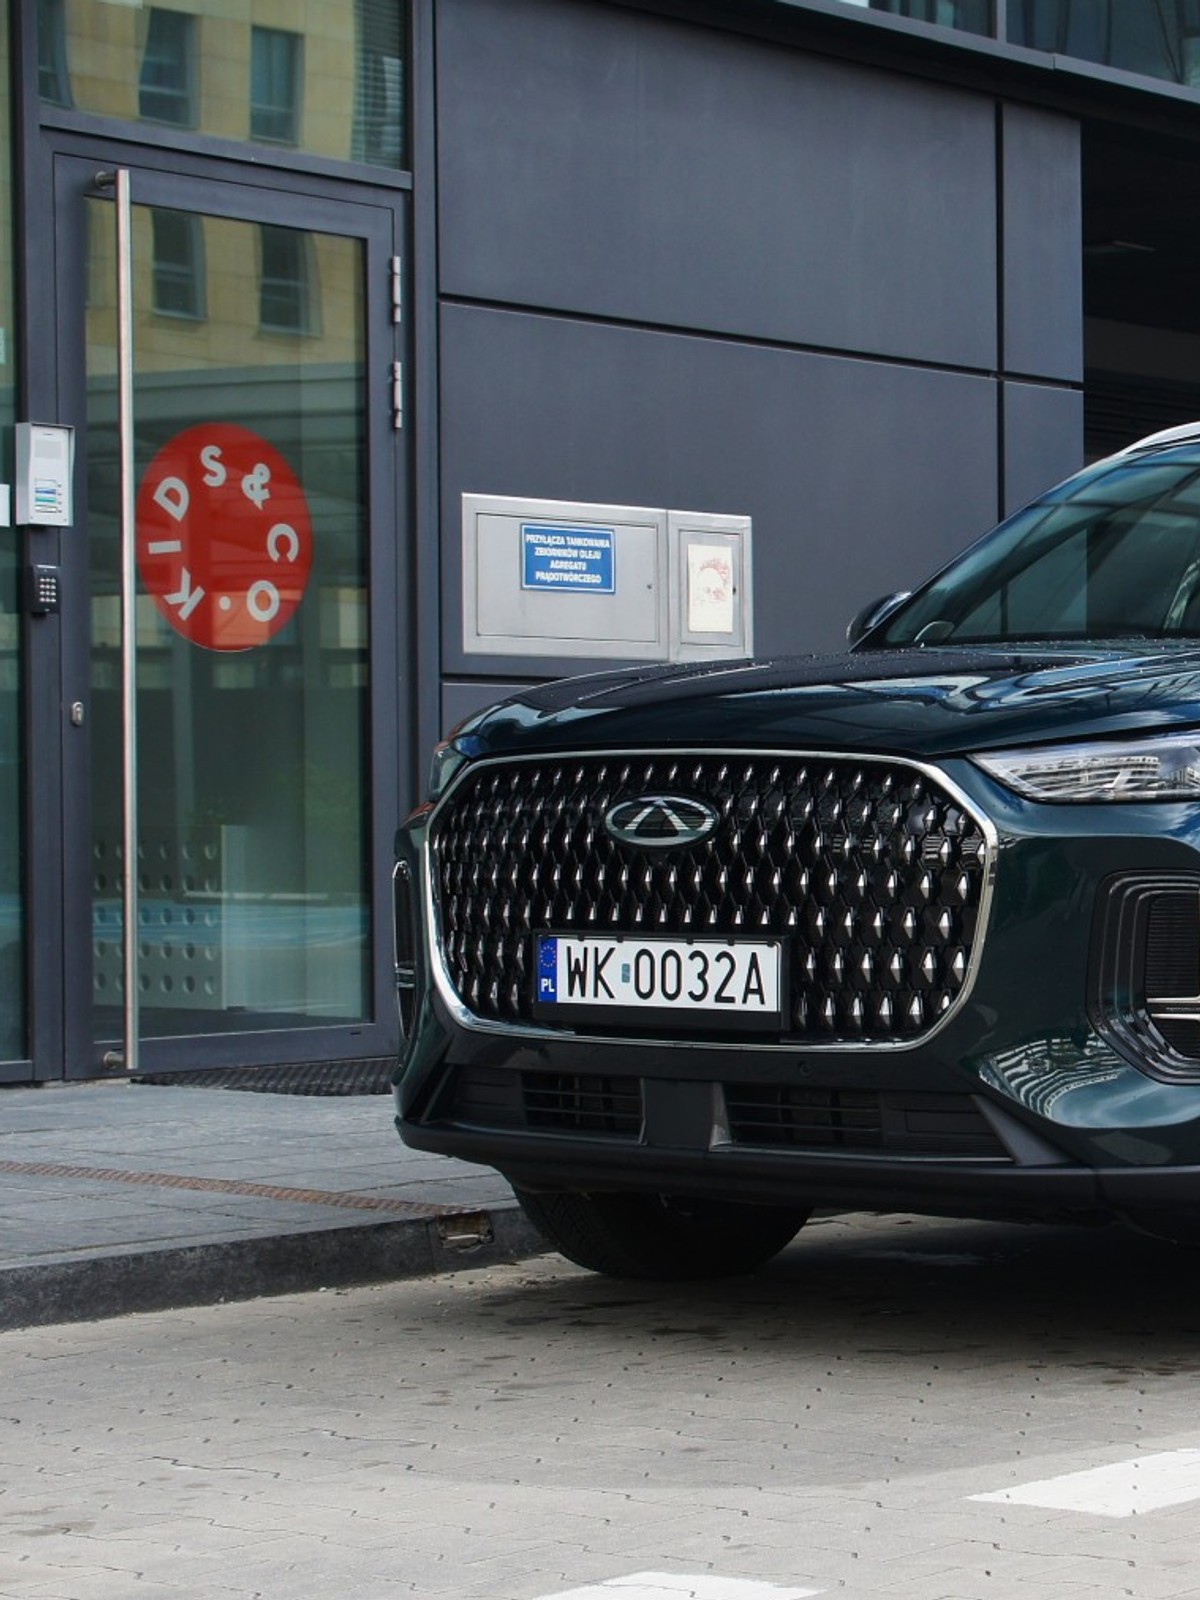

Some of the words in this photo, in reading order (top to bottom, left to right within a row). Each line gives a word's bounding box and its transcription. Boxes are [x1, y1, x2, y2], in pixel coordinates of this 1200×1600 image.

[149, 445, 227, 621] KIDS
[241, 463, 271, 511] &
[579, 549, 602, 560] OLEJU
[550, 560, 587, 571] AGREGATU
[566, 945, 616, 999] WK
[634, 948, 766, 1005] 0032A
[541, 978, 555, 992] PL
